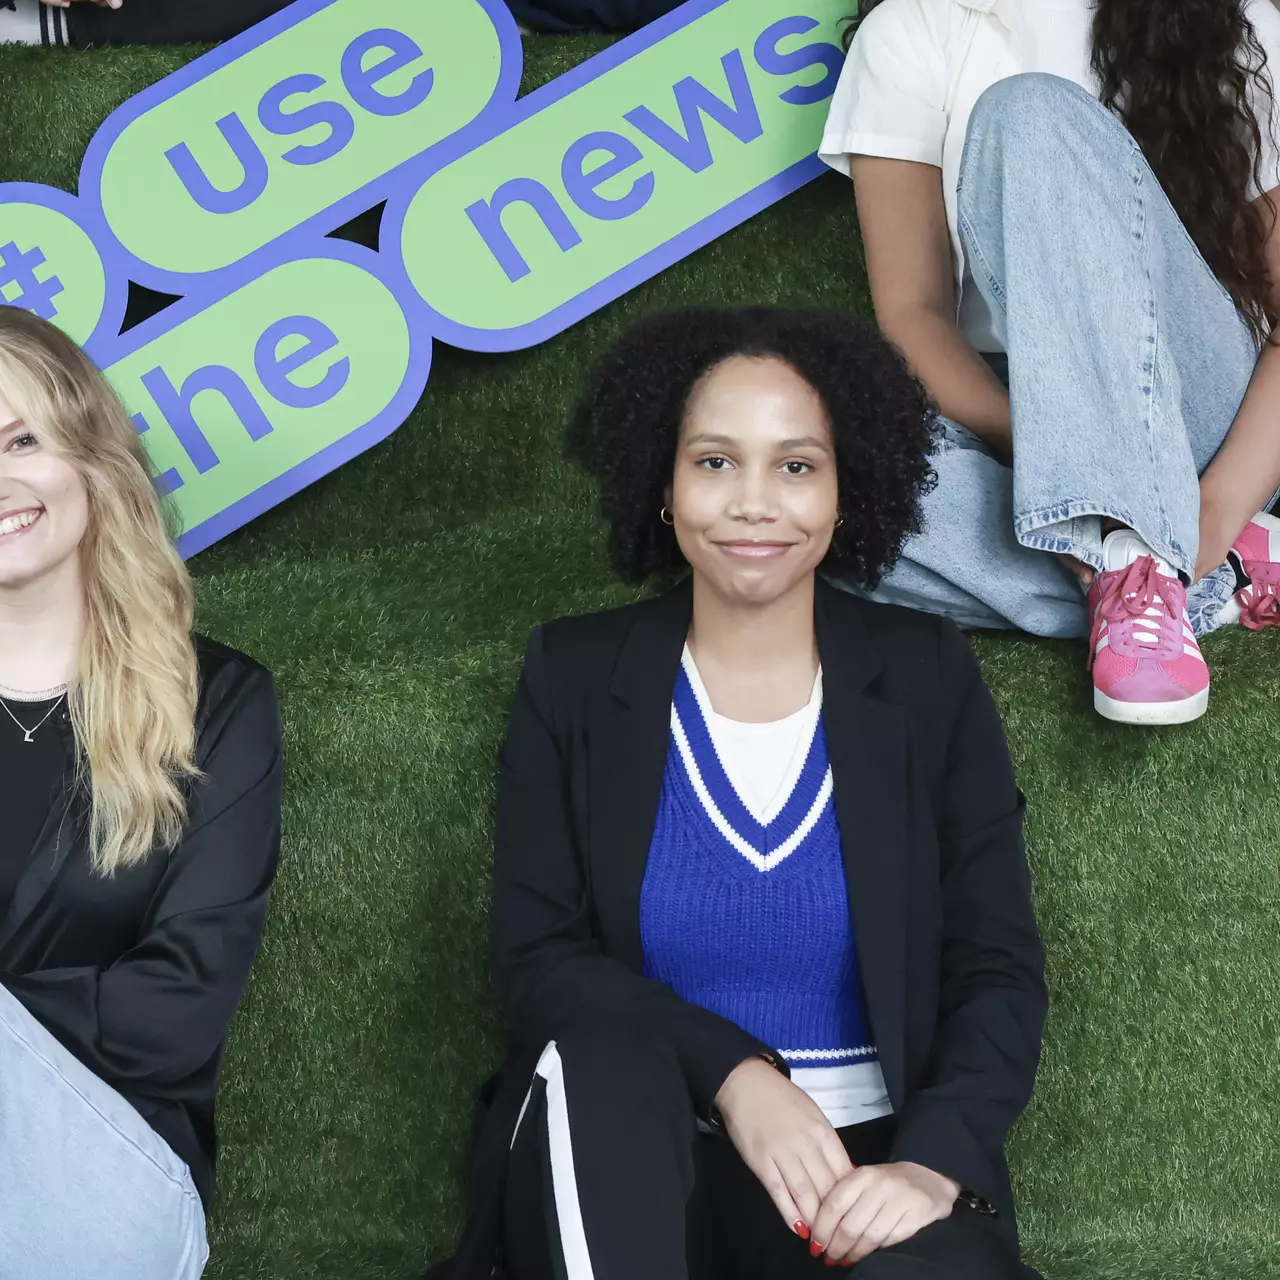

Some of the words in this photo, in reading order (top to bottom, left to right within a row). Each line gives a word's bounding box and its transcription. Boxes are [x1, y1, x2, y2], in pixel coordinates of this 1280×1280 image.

[130, 314, 351, 498] he
[465, 15, 846, 283] news
[164, 27, 435, 215] use
